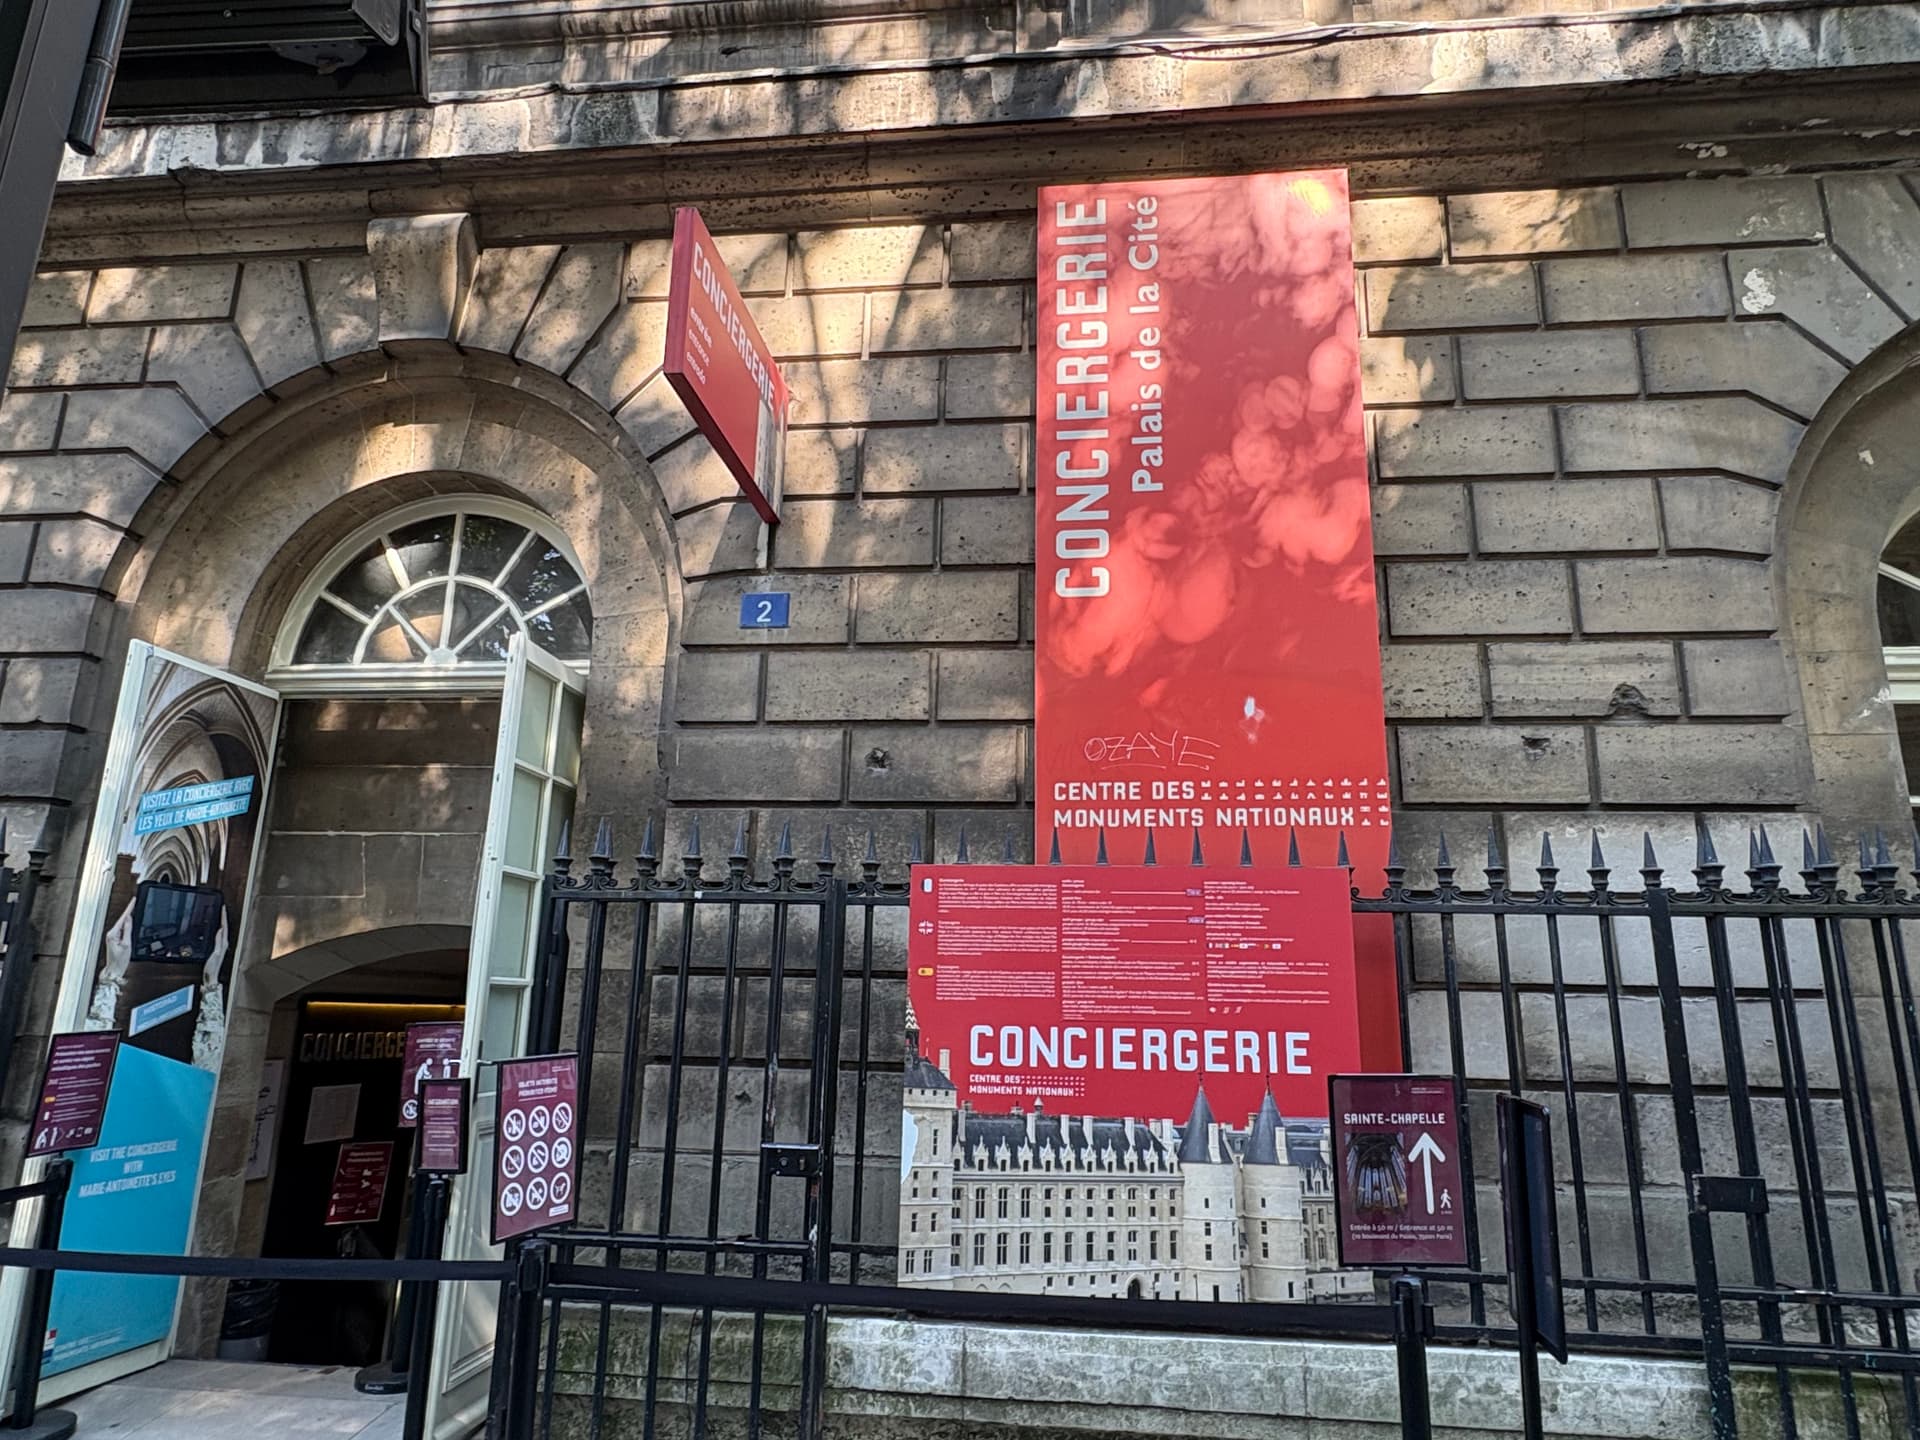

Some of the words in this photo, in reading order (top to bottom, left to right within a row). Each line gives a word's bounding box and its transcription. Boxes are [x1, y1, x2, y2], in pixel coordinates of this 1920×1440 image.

[1128, 196, 1159, 270] Cité
[1129, 282, 1160, 314] la
[693, 242, 775, 411] CONCIERGERIE
[1130, 327, 1161, 370] de
[1055, 198, 1110, 598] CONCIERGERIE
[1131, 383, 1164, 492] Palais
[757, 600, 772, 622] 2
[1054, 781, 1142, 801] CENTRE
[1151, 780, 1195, 800] DES
[1054, 808, 1204, 828] MONUMENTS
[1216, 806, 1354, 827] NATIONAUX
[969, 1024, 1312, 1075] CONCIERGERIE
[969, 1074, 1001, 1083] CENTRE
[1004, 1075, 1020, 1084] DES
[969, 1085, 1022, 1095] MONUMENTS
[1025, 1086, 1074, 1097] NATIONAUX
[1344, 1112, 1446, 1125] SAINTE-CHAPELLE
